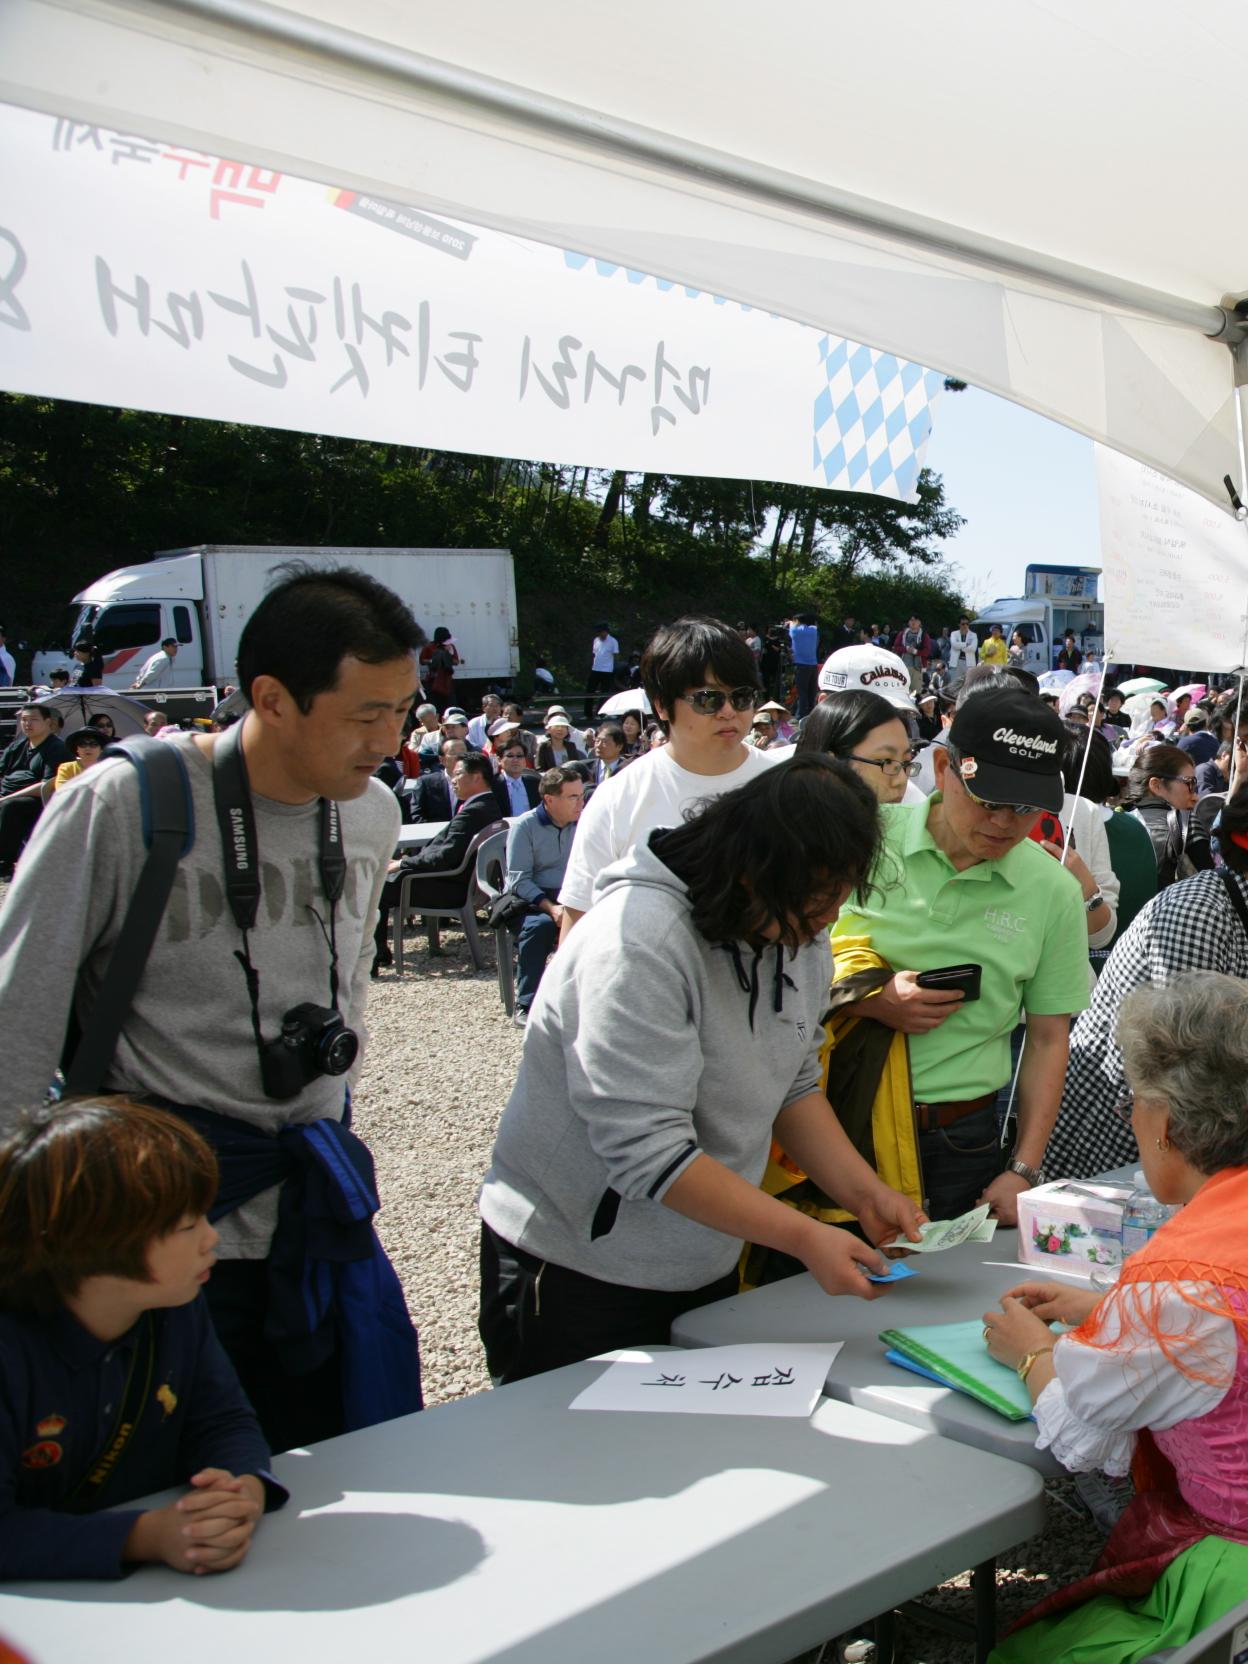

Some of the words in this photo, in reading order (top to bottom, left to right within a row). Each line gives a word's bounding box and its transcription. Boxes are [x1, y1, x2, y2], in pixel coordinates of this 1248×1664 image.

[860, 664, 908, 686] Callaway
[993, 727, 1059, 754] Cleveland
[1009, 746, 1043, 759] GOLF
[229, 807, 249, 870] SAMSUNG
[89, 1423, 131, 1483] Nikon
